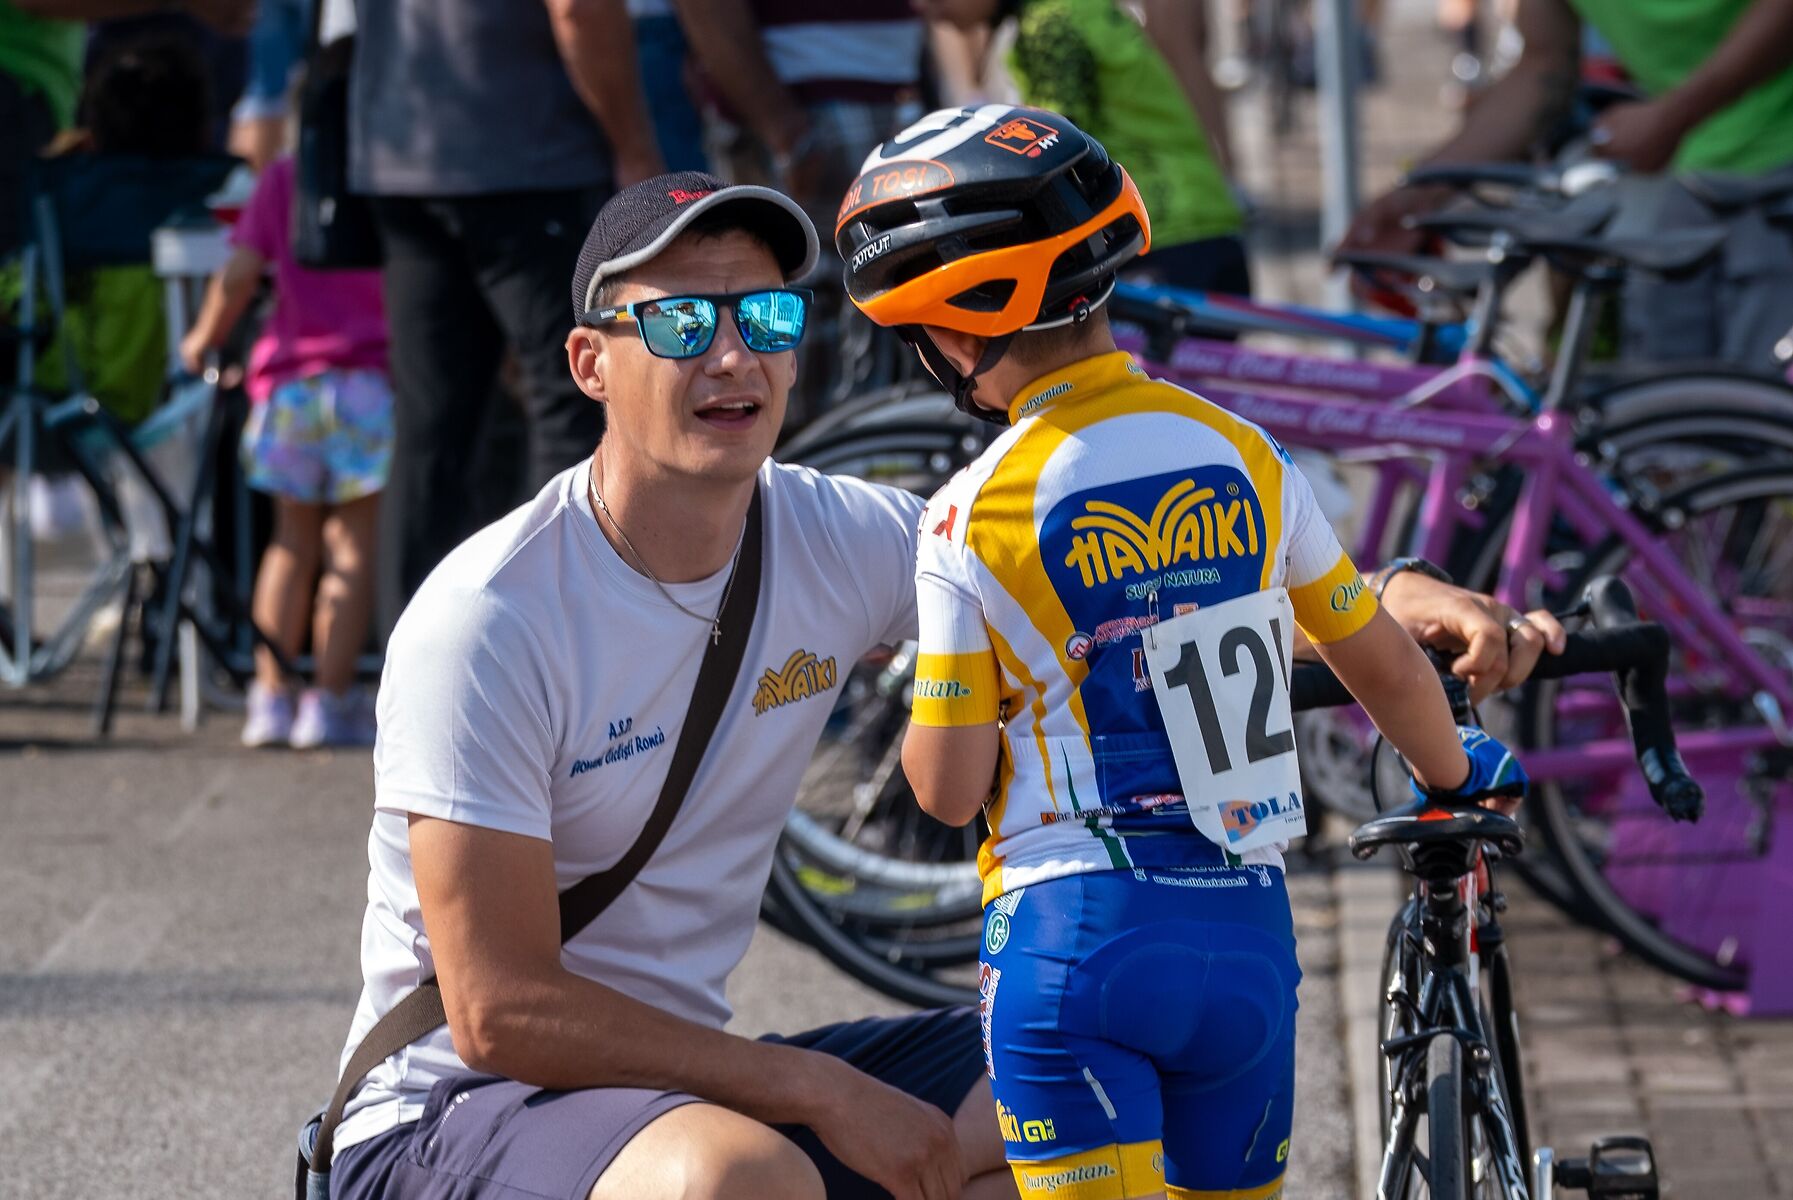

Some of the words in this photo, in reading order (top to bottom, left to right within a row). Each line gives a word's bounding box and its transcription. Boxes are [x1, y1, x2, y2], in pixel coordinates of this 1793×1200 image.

[1065, 479, 1258, 589] HAWAIKI
[1163, 567, 1221, 588] NATURA
[752, 649, 837, 717] HAWAIKI
